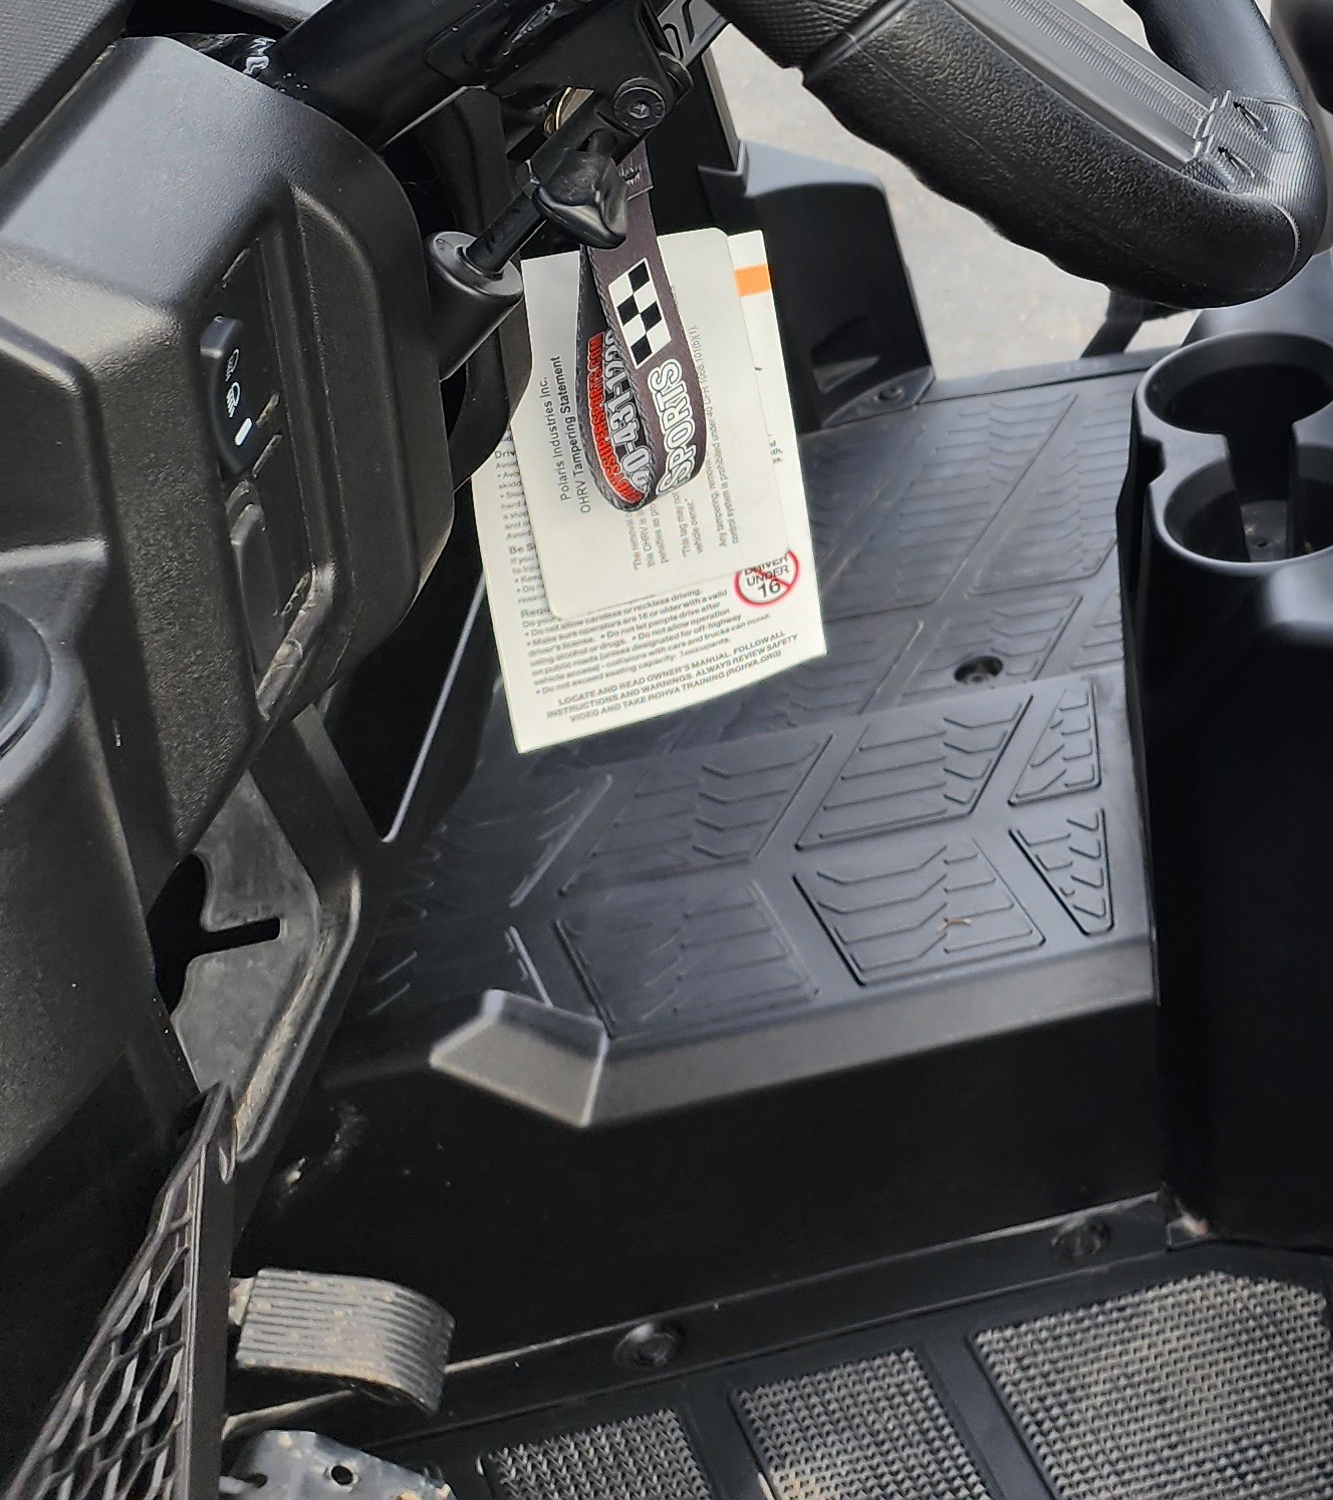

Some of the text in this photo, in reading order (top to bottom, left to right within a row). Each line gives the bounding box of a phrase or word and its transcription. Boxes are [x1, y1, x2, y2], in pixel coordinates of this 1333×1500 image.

[538, 376, 570, 499] Polaris Industries Inc.
[551, 355, 591, 513] OHRV Tampering Statement
[648, 358, 696, 496] SPORTS
[746, 565, 789, 585] UNDER
[757, 579, 781, 597] 16
